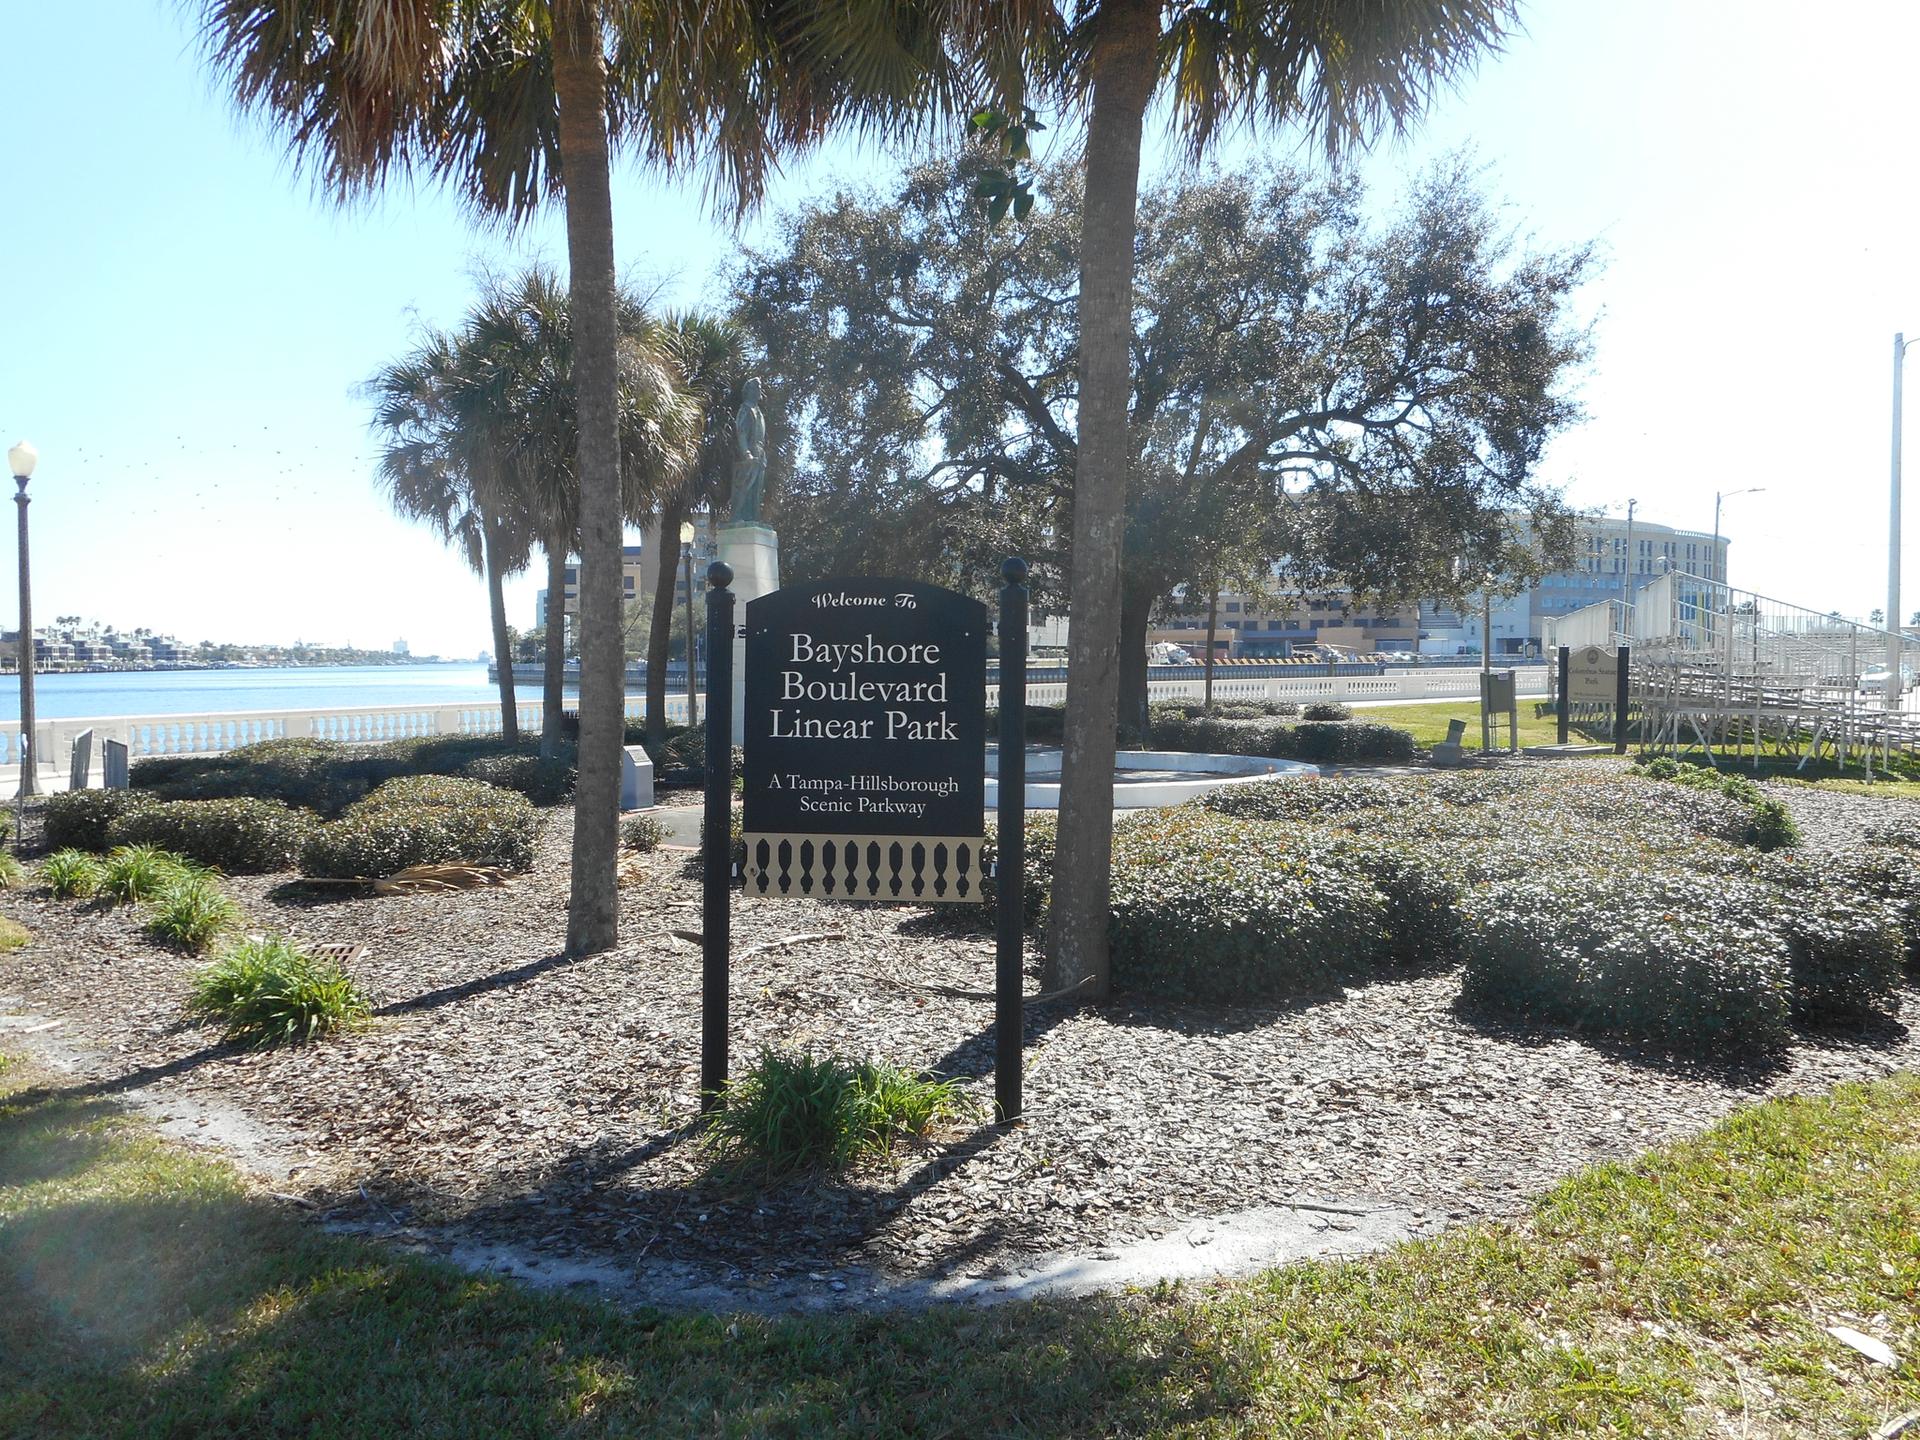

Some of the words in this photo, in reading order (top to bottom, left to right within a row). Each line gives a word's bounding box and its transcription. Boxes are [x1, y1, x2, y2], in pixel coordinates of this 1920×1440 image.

[812, 592, 887, 608] Welcome
[895, 594, 916, 609] To
[790, 634, 939, 671] Bayshore
[781, 671, 948, 702] Boulevard
[769, 709, 873, 739] Linear
[885, 711, 959, 740] Park
[768, 774, 782, 788] A
[787, 774, 958, 797] Tampa-Hillsborough
[801, 797, 852, 812] Scenic
[858, 798, 926, 818] Parkway
